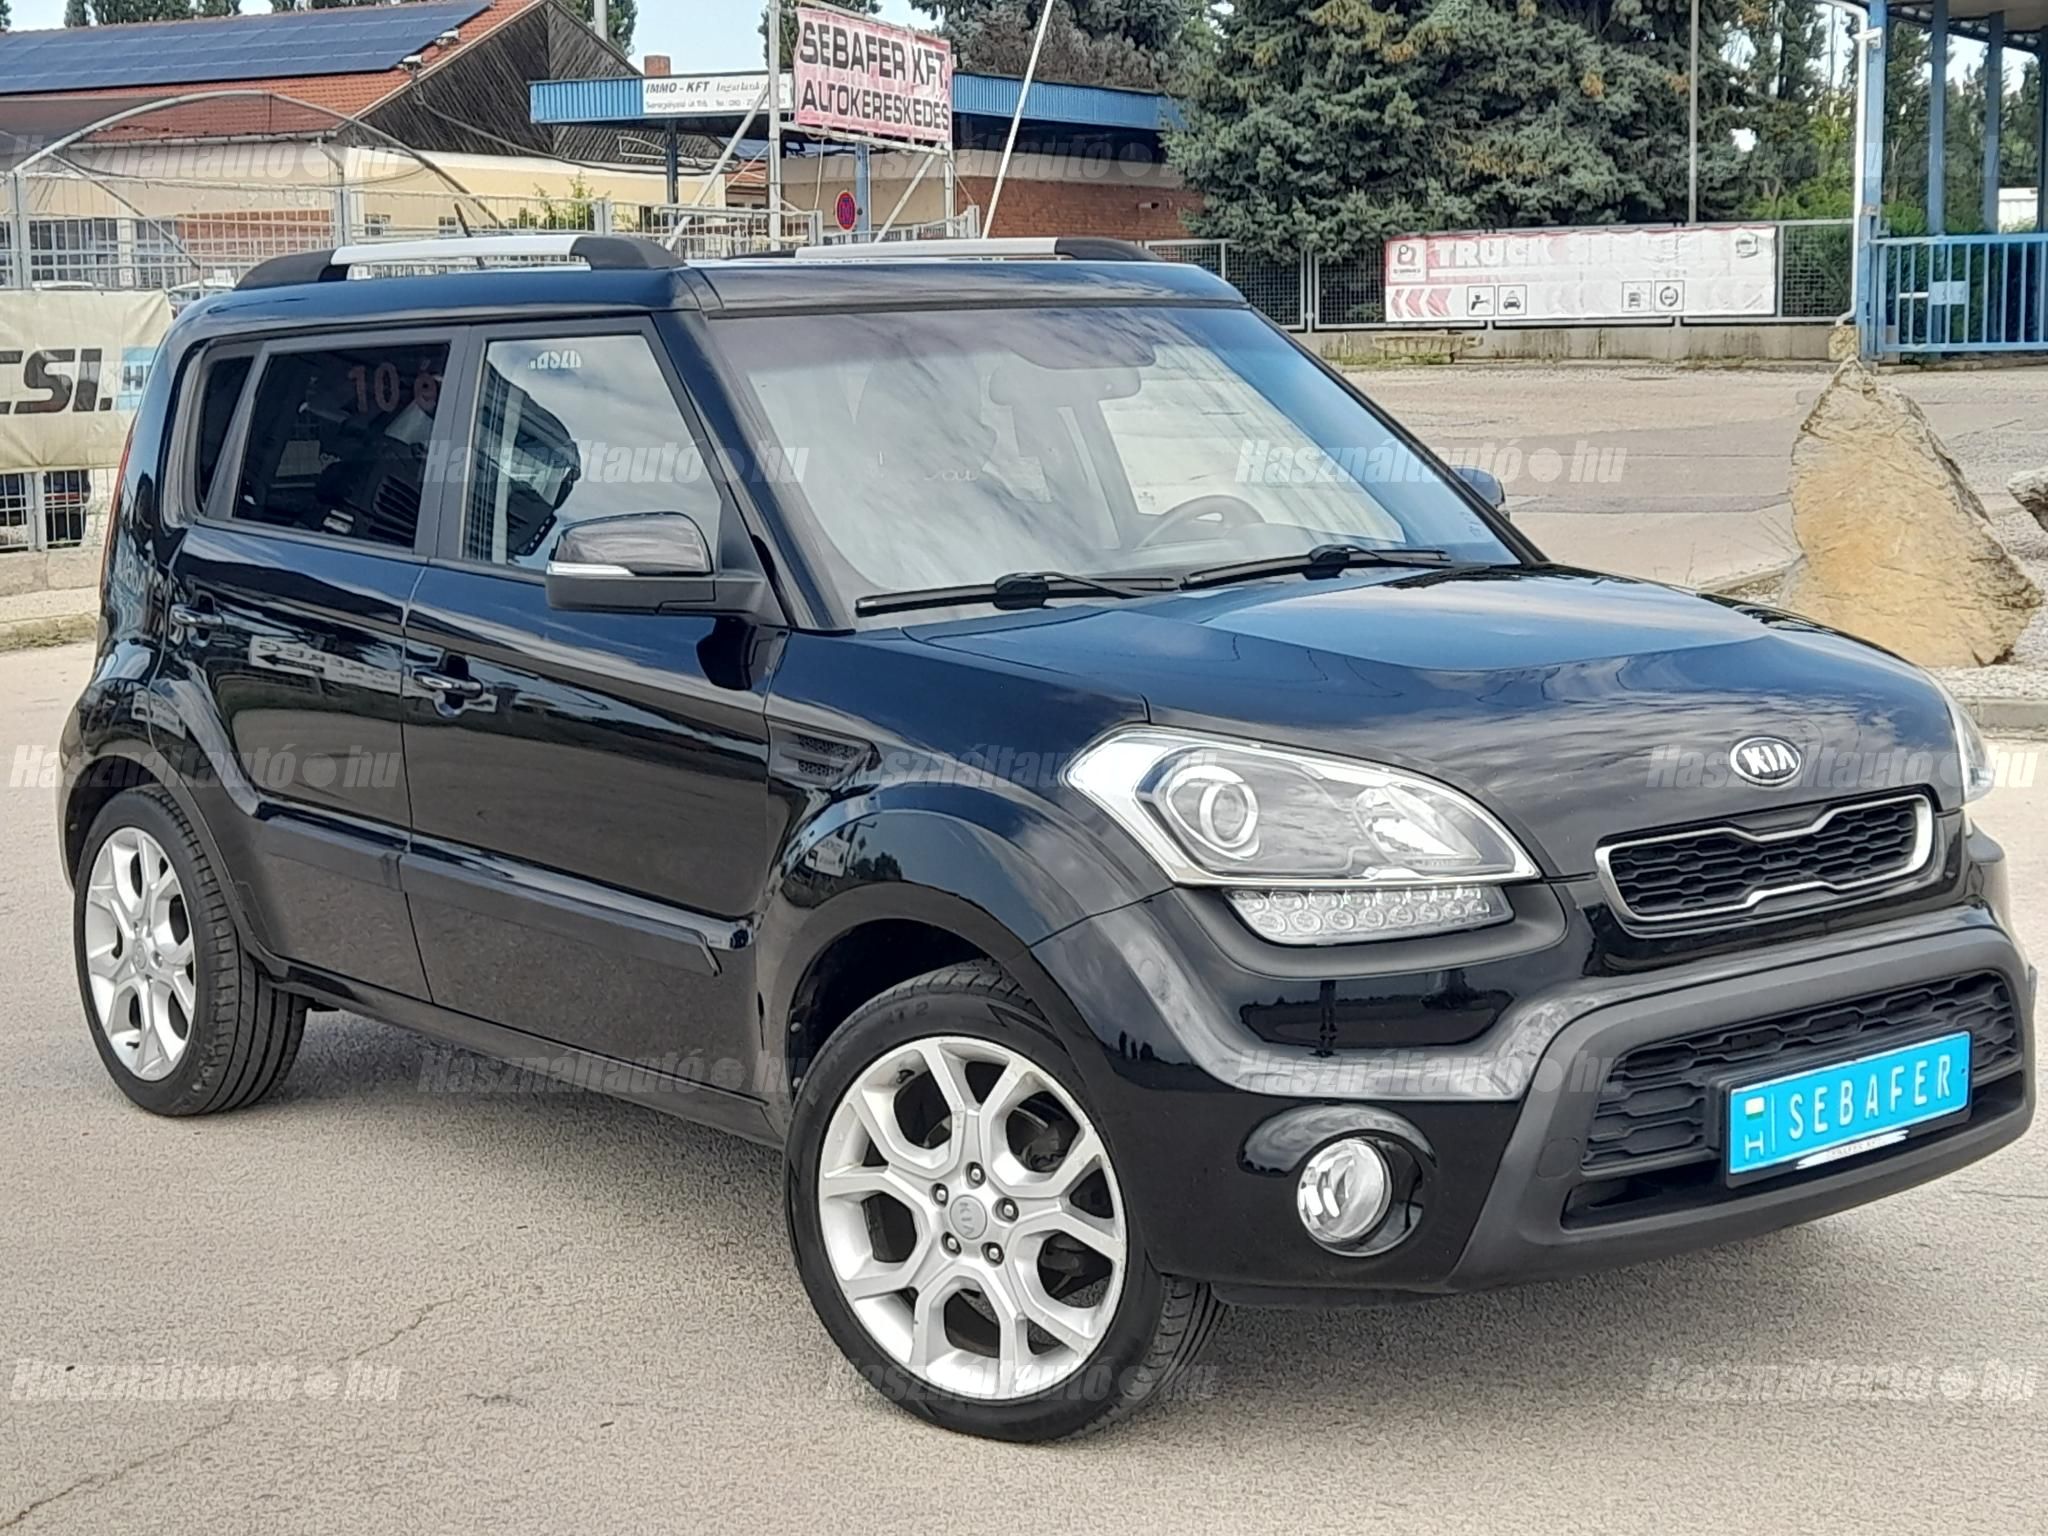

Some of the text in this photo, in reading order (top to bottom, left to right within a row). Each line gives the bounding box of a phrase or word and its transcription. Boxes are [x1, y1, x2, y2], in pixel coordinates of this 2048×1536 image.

[799, 21, 906, 82] SEBAFER
[646, 82, 678, 94] IMMO
[686, 81, 710, 93] KFT
[1432, 237, 1553, 267] TRUCK
[1741, 743, 1797, 776] KIA
[1788, 1055, 1951, 1140] SEBAFER
